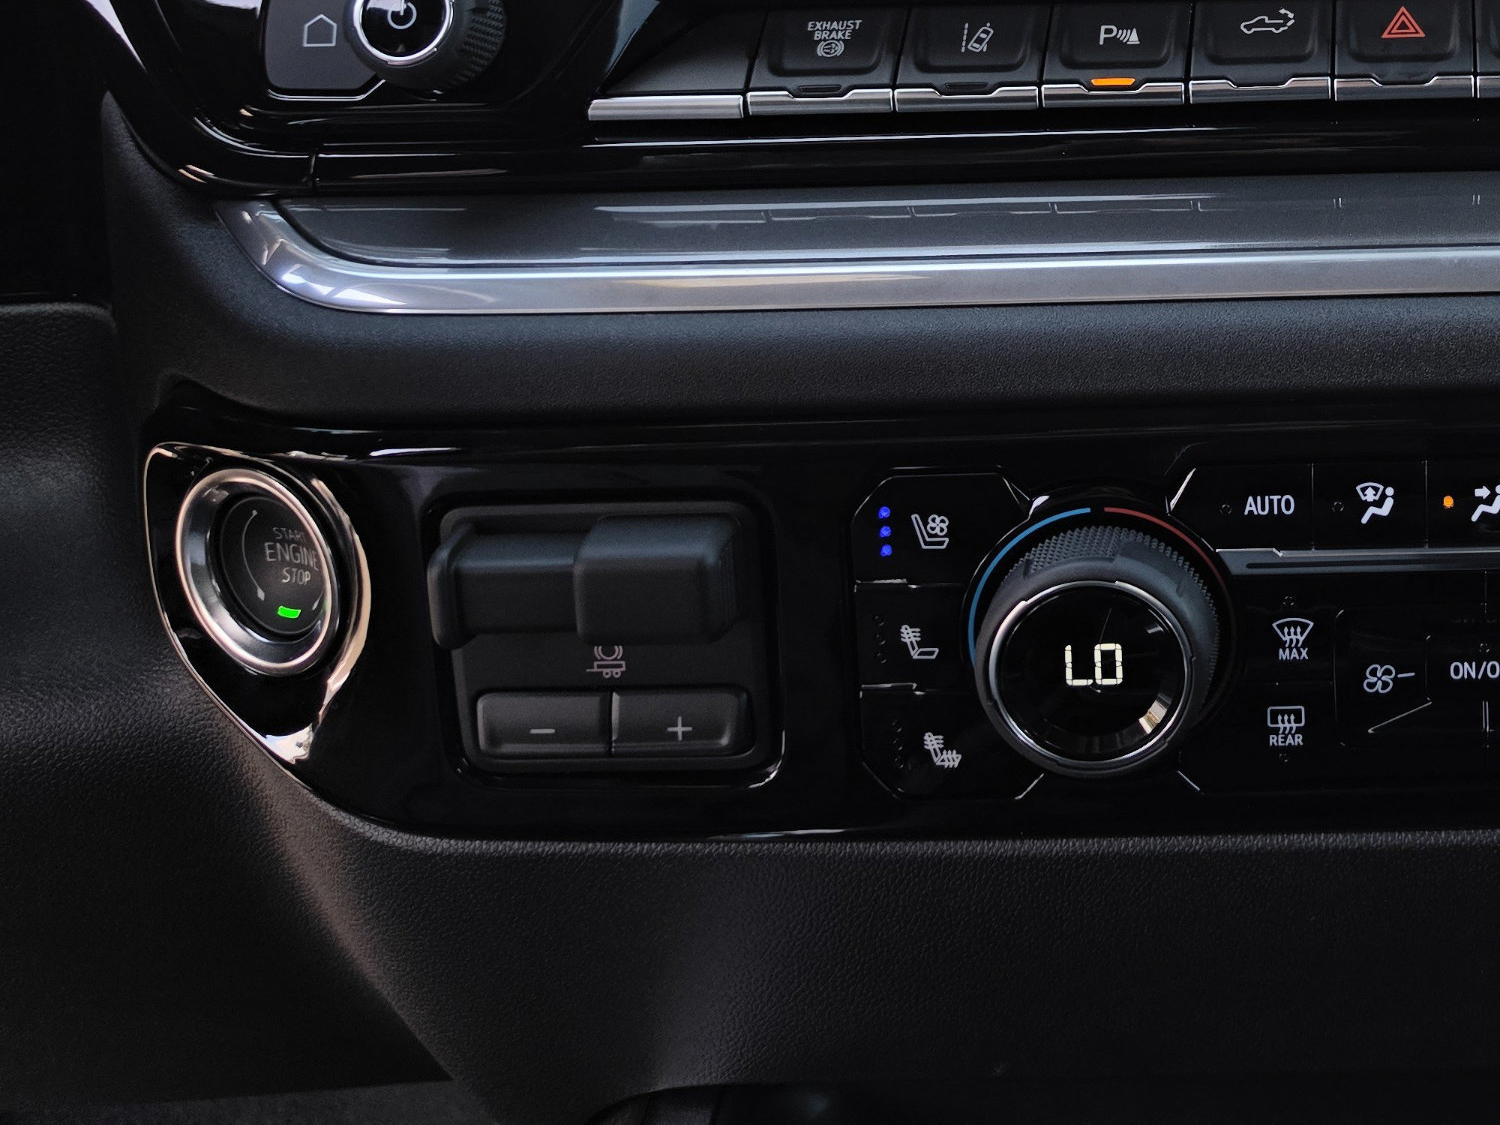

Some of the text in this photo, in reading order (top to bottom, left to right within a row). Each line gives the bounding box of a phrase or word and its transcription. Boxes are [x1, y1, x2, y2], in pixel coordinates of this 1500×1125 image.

[807, 19, 863, 32] EXHAUST
[813, 29, 853, 42] BRAKE
[1244, 494, 1296, 516] AUTO
[264, 541, 320, 572] ENGINE
[281, 566, 312, 586] STOP
[1278, 647, 1309, 661] MAX
[1269, 733, 1304, 747] REAR
